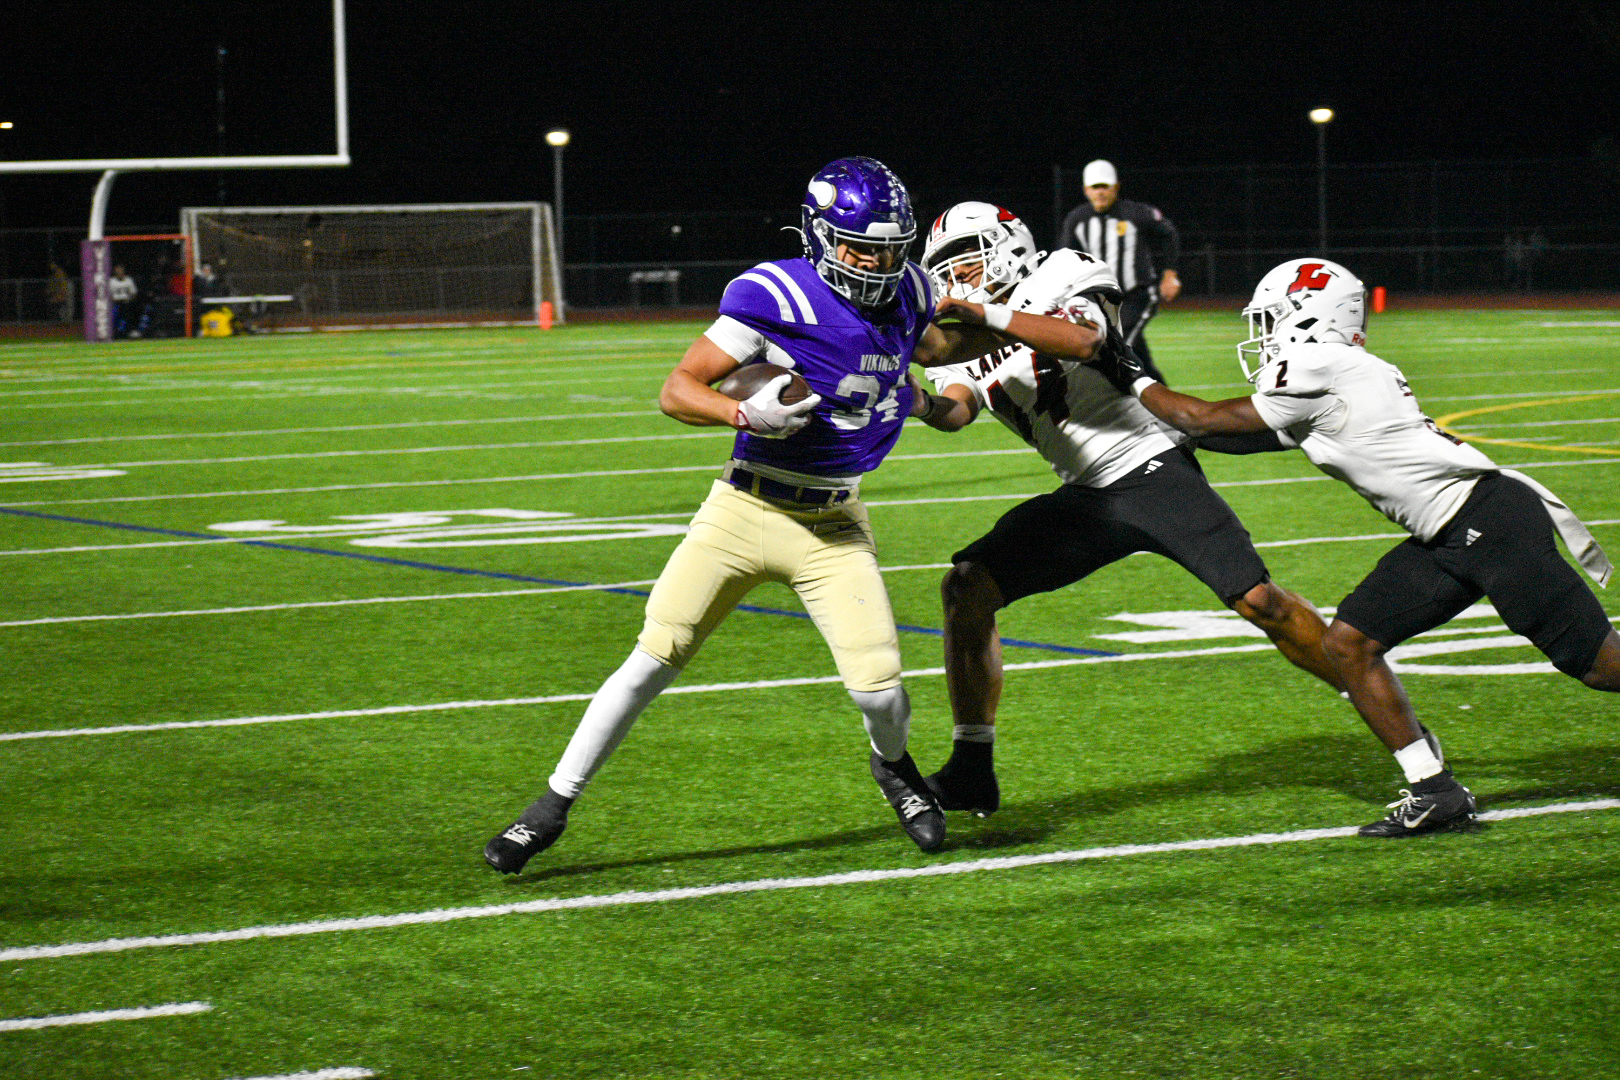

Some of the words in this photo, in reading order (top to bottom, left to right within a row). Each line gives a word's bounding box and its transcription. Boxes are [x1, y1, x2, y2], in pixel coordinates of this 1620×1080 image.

[1286, 263, 1331, 295] L
[860, 354, 902, 372] VIKINGS
[1275, 360, 1289, 389] 2
[830, 372, 906, 430] 34
